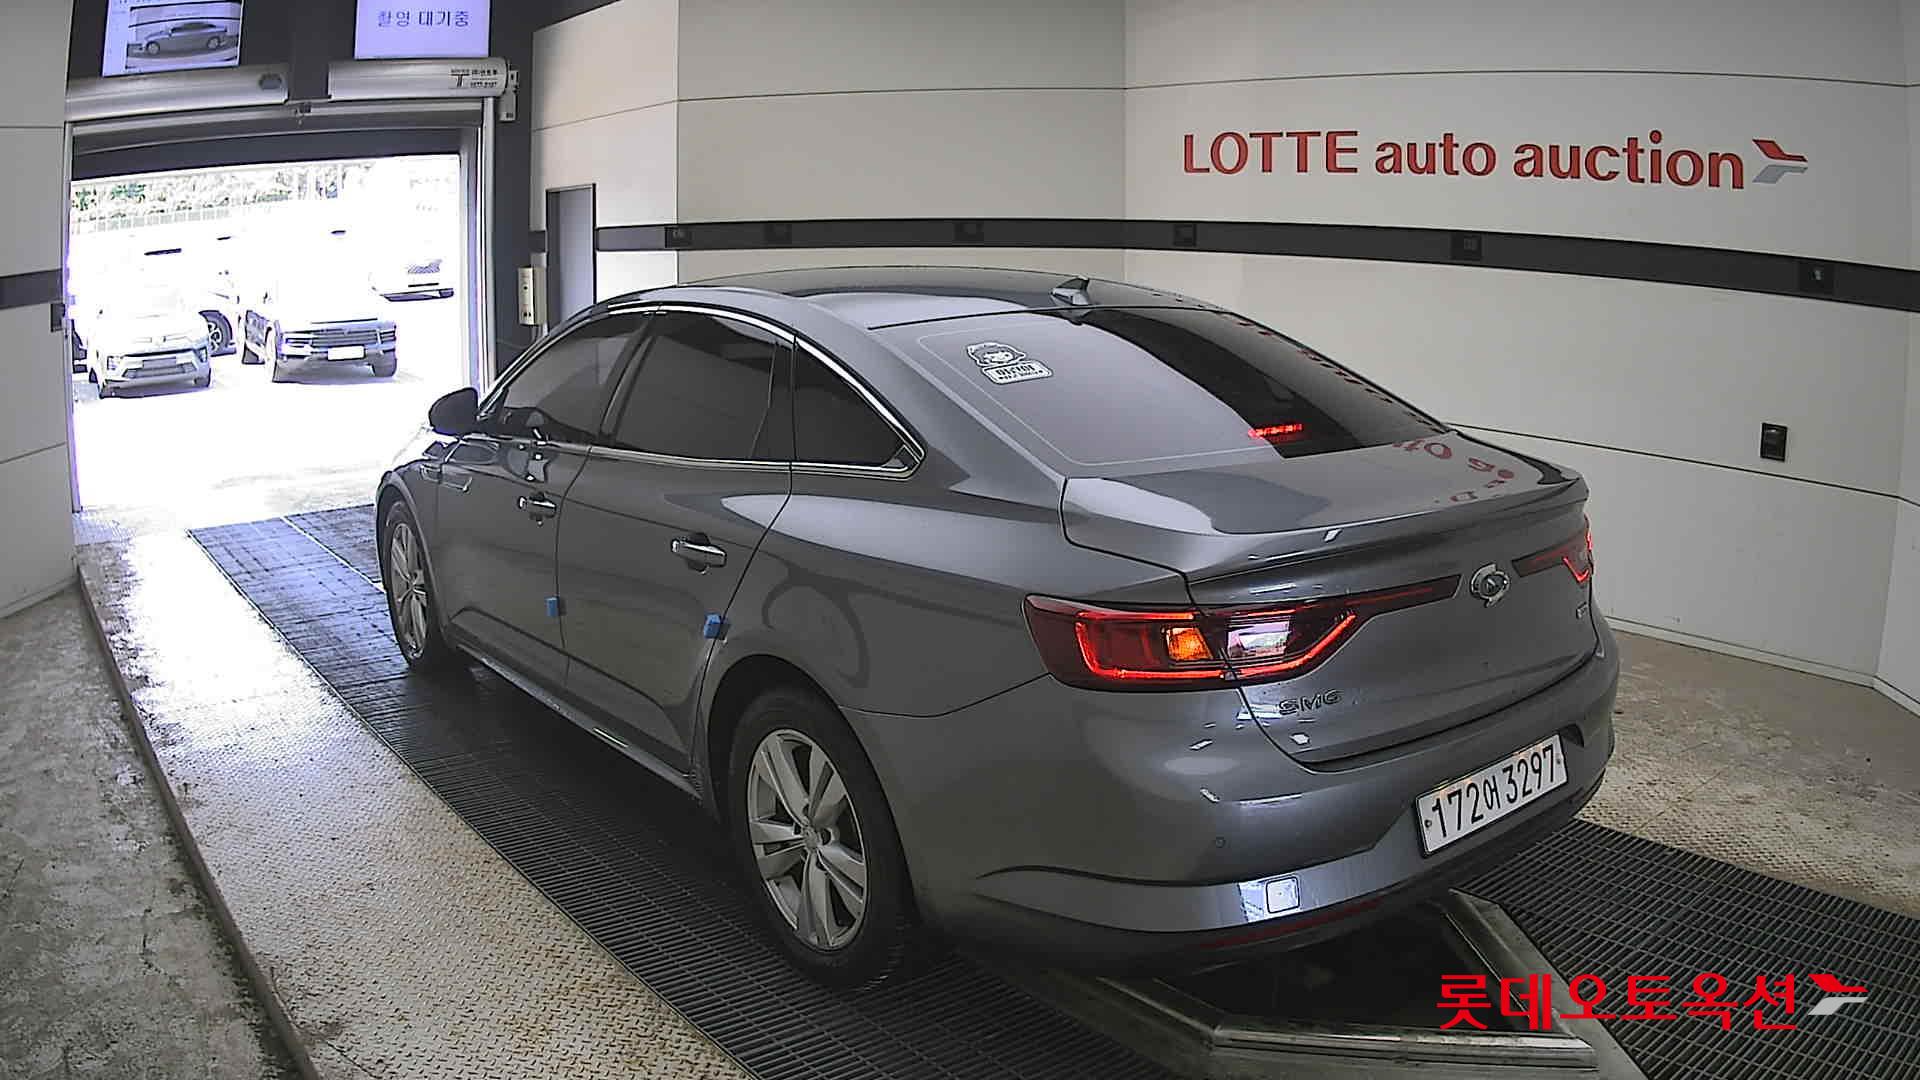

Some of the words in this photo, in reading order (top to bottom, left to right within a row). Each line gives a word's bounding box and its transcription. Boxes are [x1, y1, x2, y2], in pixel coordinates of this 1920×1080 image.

[1184, 131, 1358, 174] LOTTE
[1375, 132, 1497, 177] auto
[1513, 129, 1745, 190] auction
